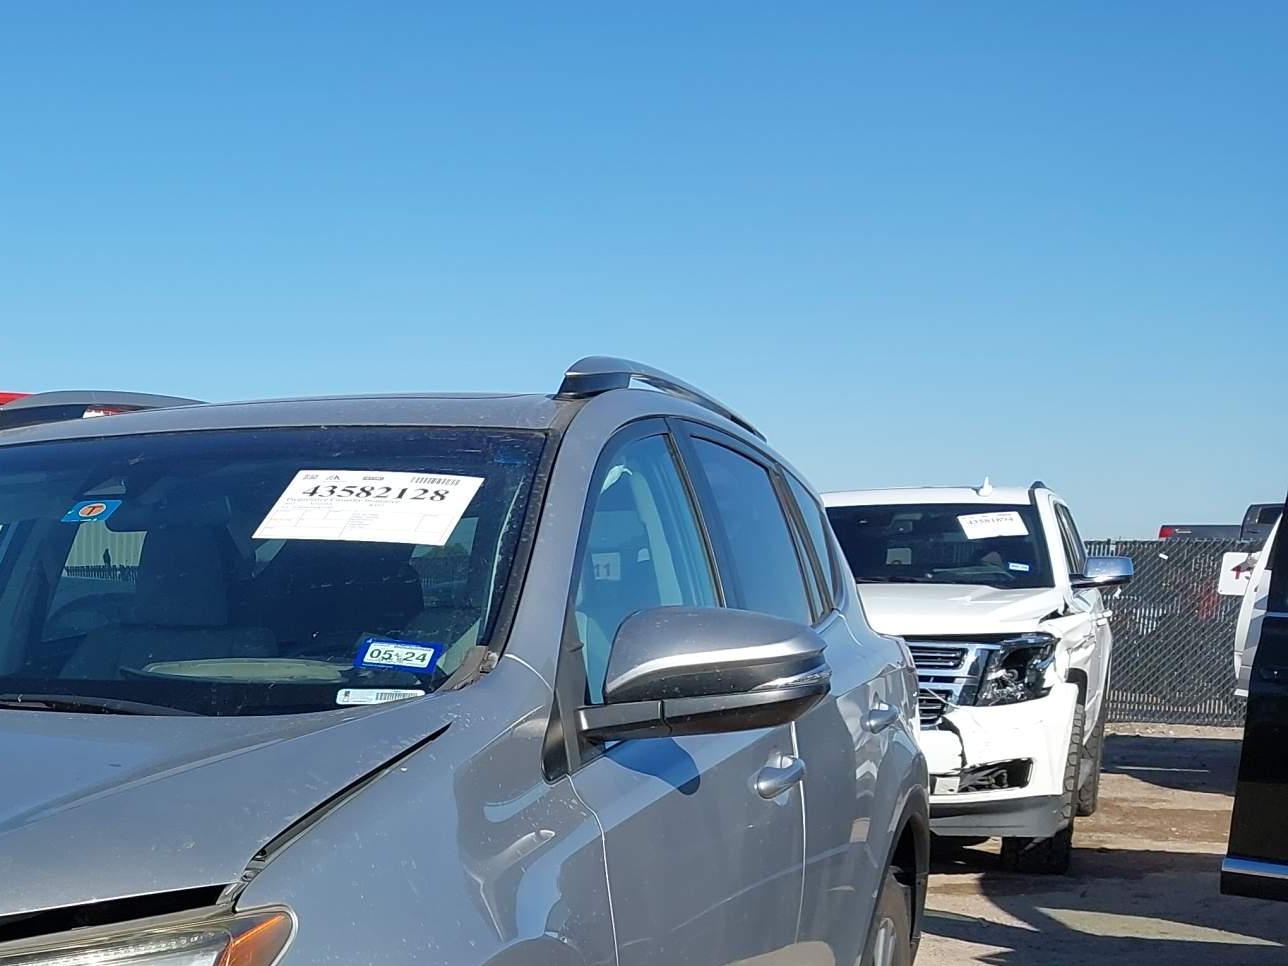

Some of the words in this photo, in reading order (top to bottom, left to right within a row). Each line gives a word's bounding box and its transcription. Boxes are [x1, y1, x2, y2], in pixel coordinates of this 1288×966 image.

[302, 485, 450, 501] 43582128
[369, 648, 394, 660] 05
[403, 651, 428, 663] 24
